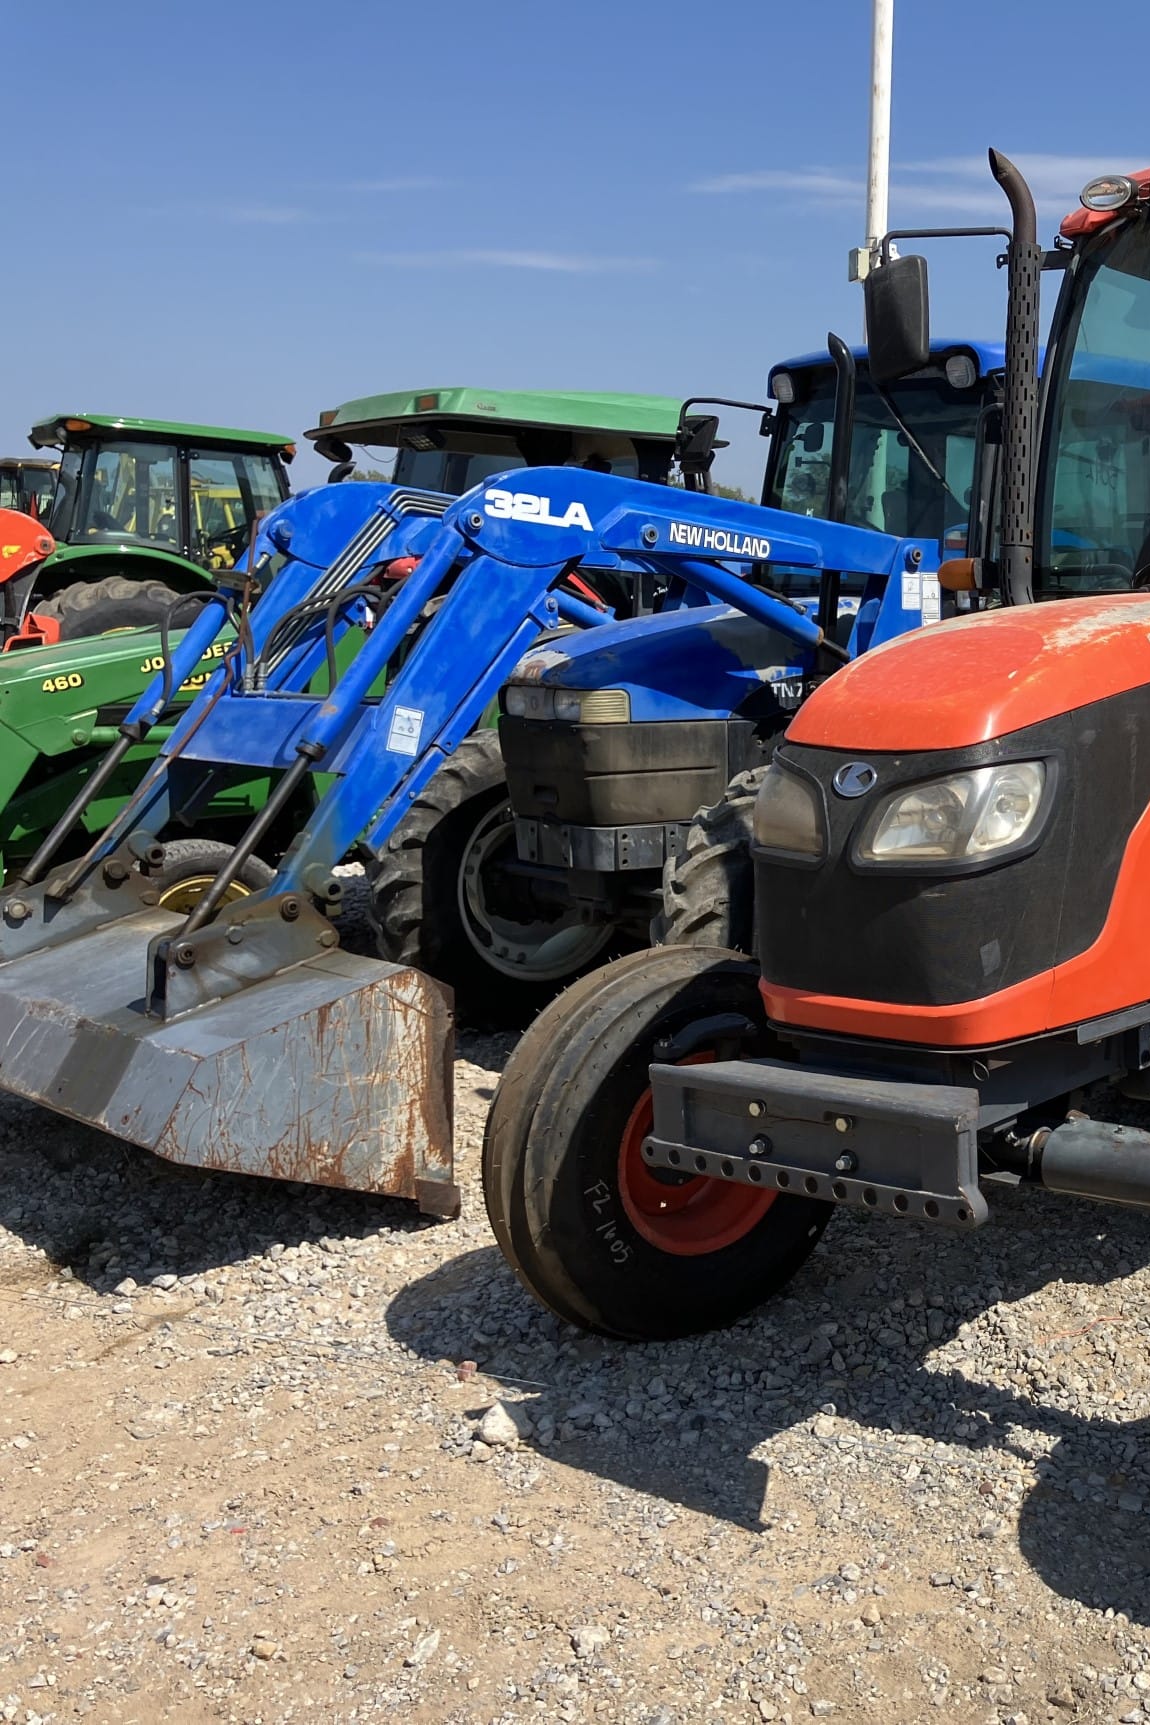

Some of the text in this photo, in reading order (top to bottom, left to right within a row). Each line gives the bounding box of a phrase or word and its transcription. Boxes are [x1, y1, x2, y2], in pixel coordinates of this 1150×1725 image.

[484, 488, 594, 532] 32LA
[669, 522, 771, 559] NEW HOLLAND
[41, 672, 85, 694] 460
